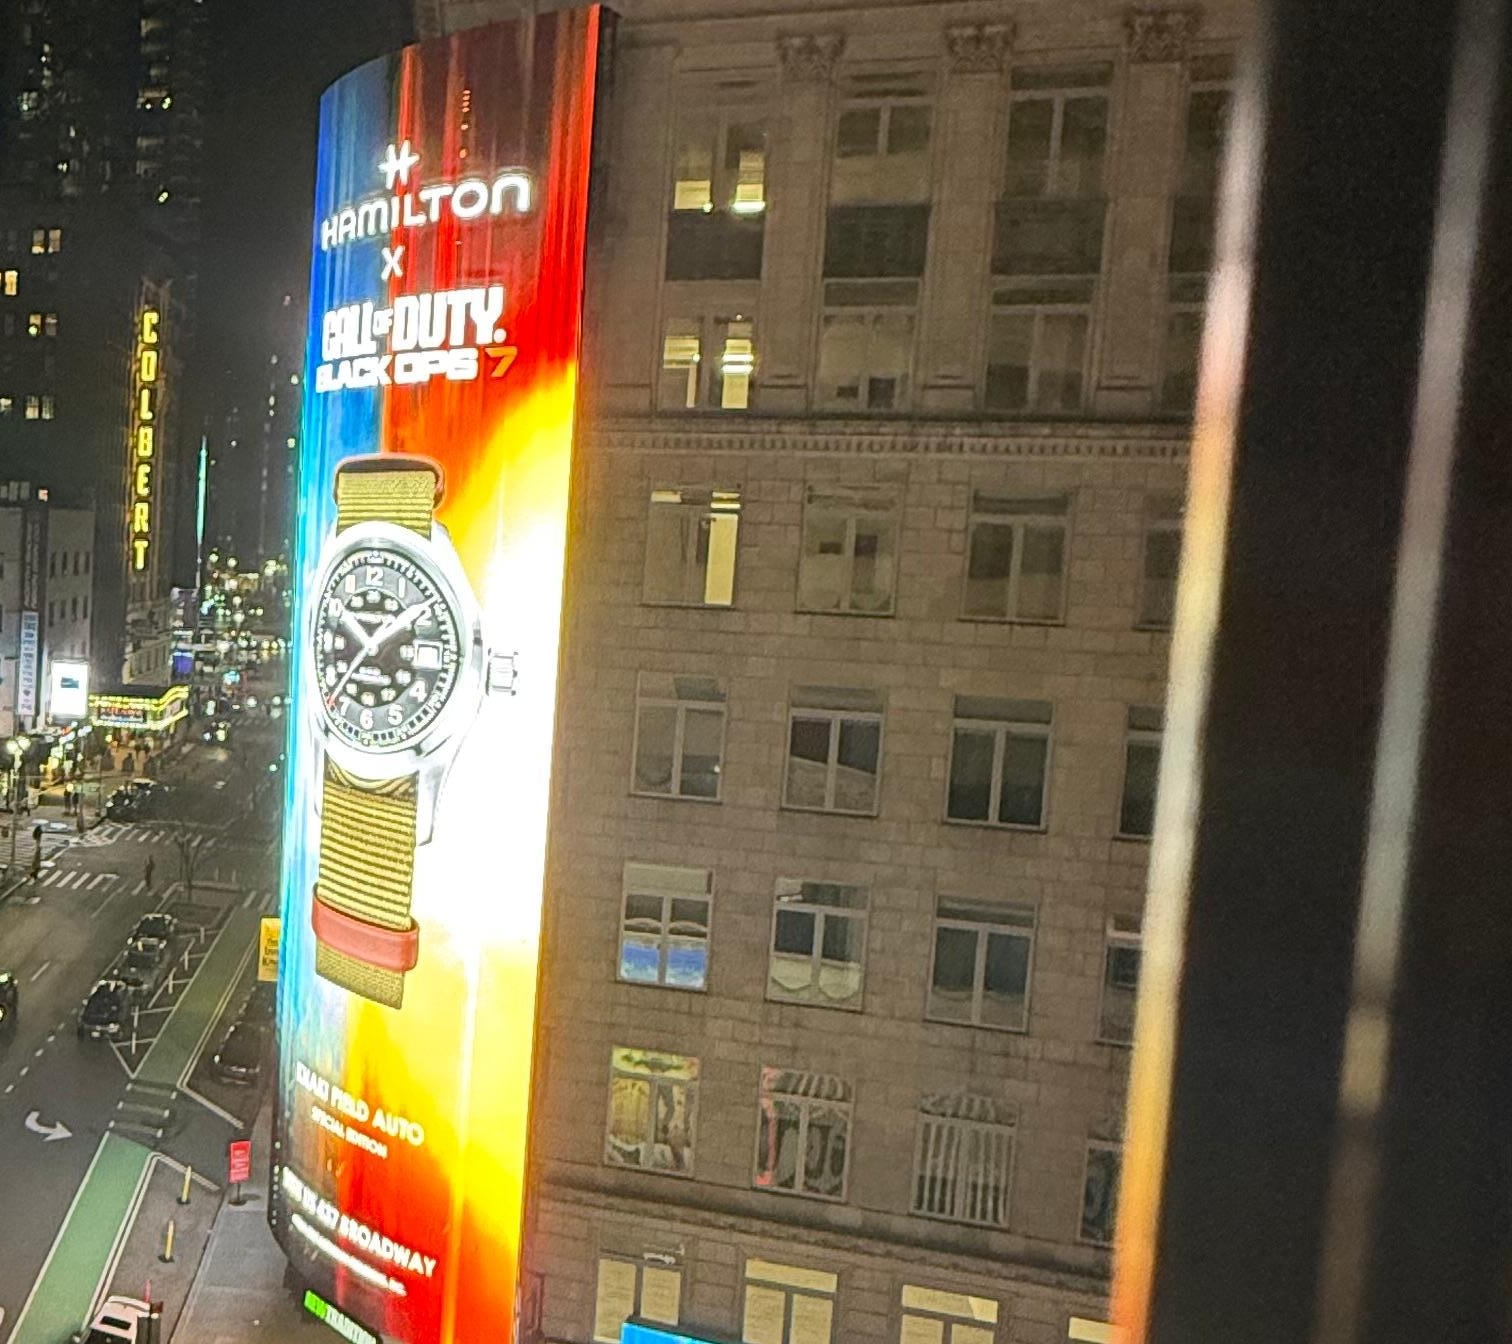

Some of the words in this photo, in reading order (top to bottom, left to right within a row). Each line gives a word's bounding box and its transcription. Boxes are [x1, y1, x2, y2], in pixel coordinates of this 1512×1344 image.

[321, 173, 531, 250] HAMILTON
[322, 302, 375, 361] CALL
[373, 307, 395, 336] OF
[315, 353, 393, 393] BLACK
[394, 346, 479, 384] OPS
[484, 345, 518, 377] 7
[134, 311, 159, 570] COLBERT
[372, 1107, 425, 1147] AUTO
